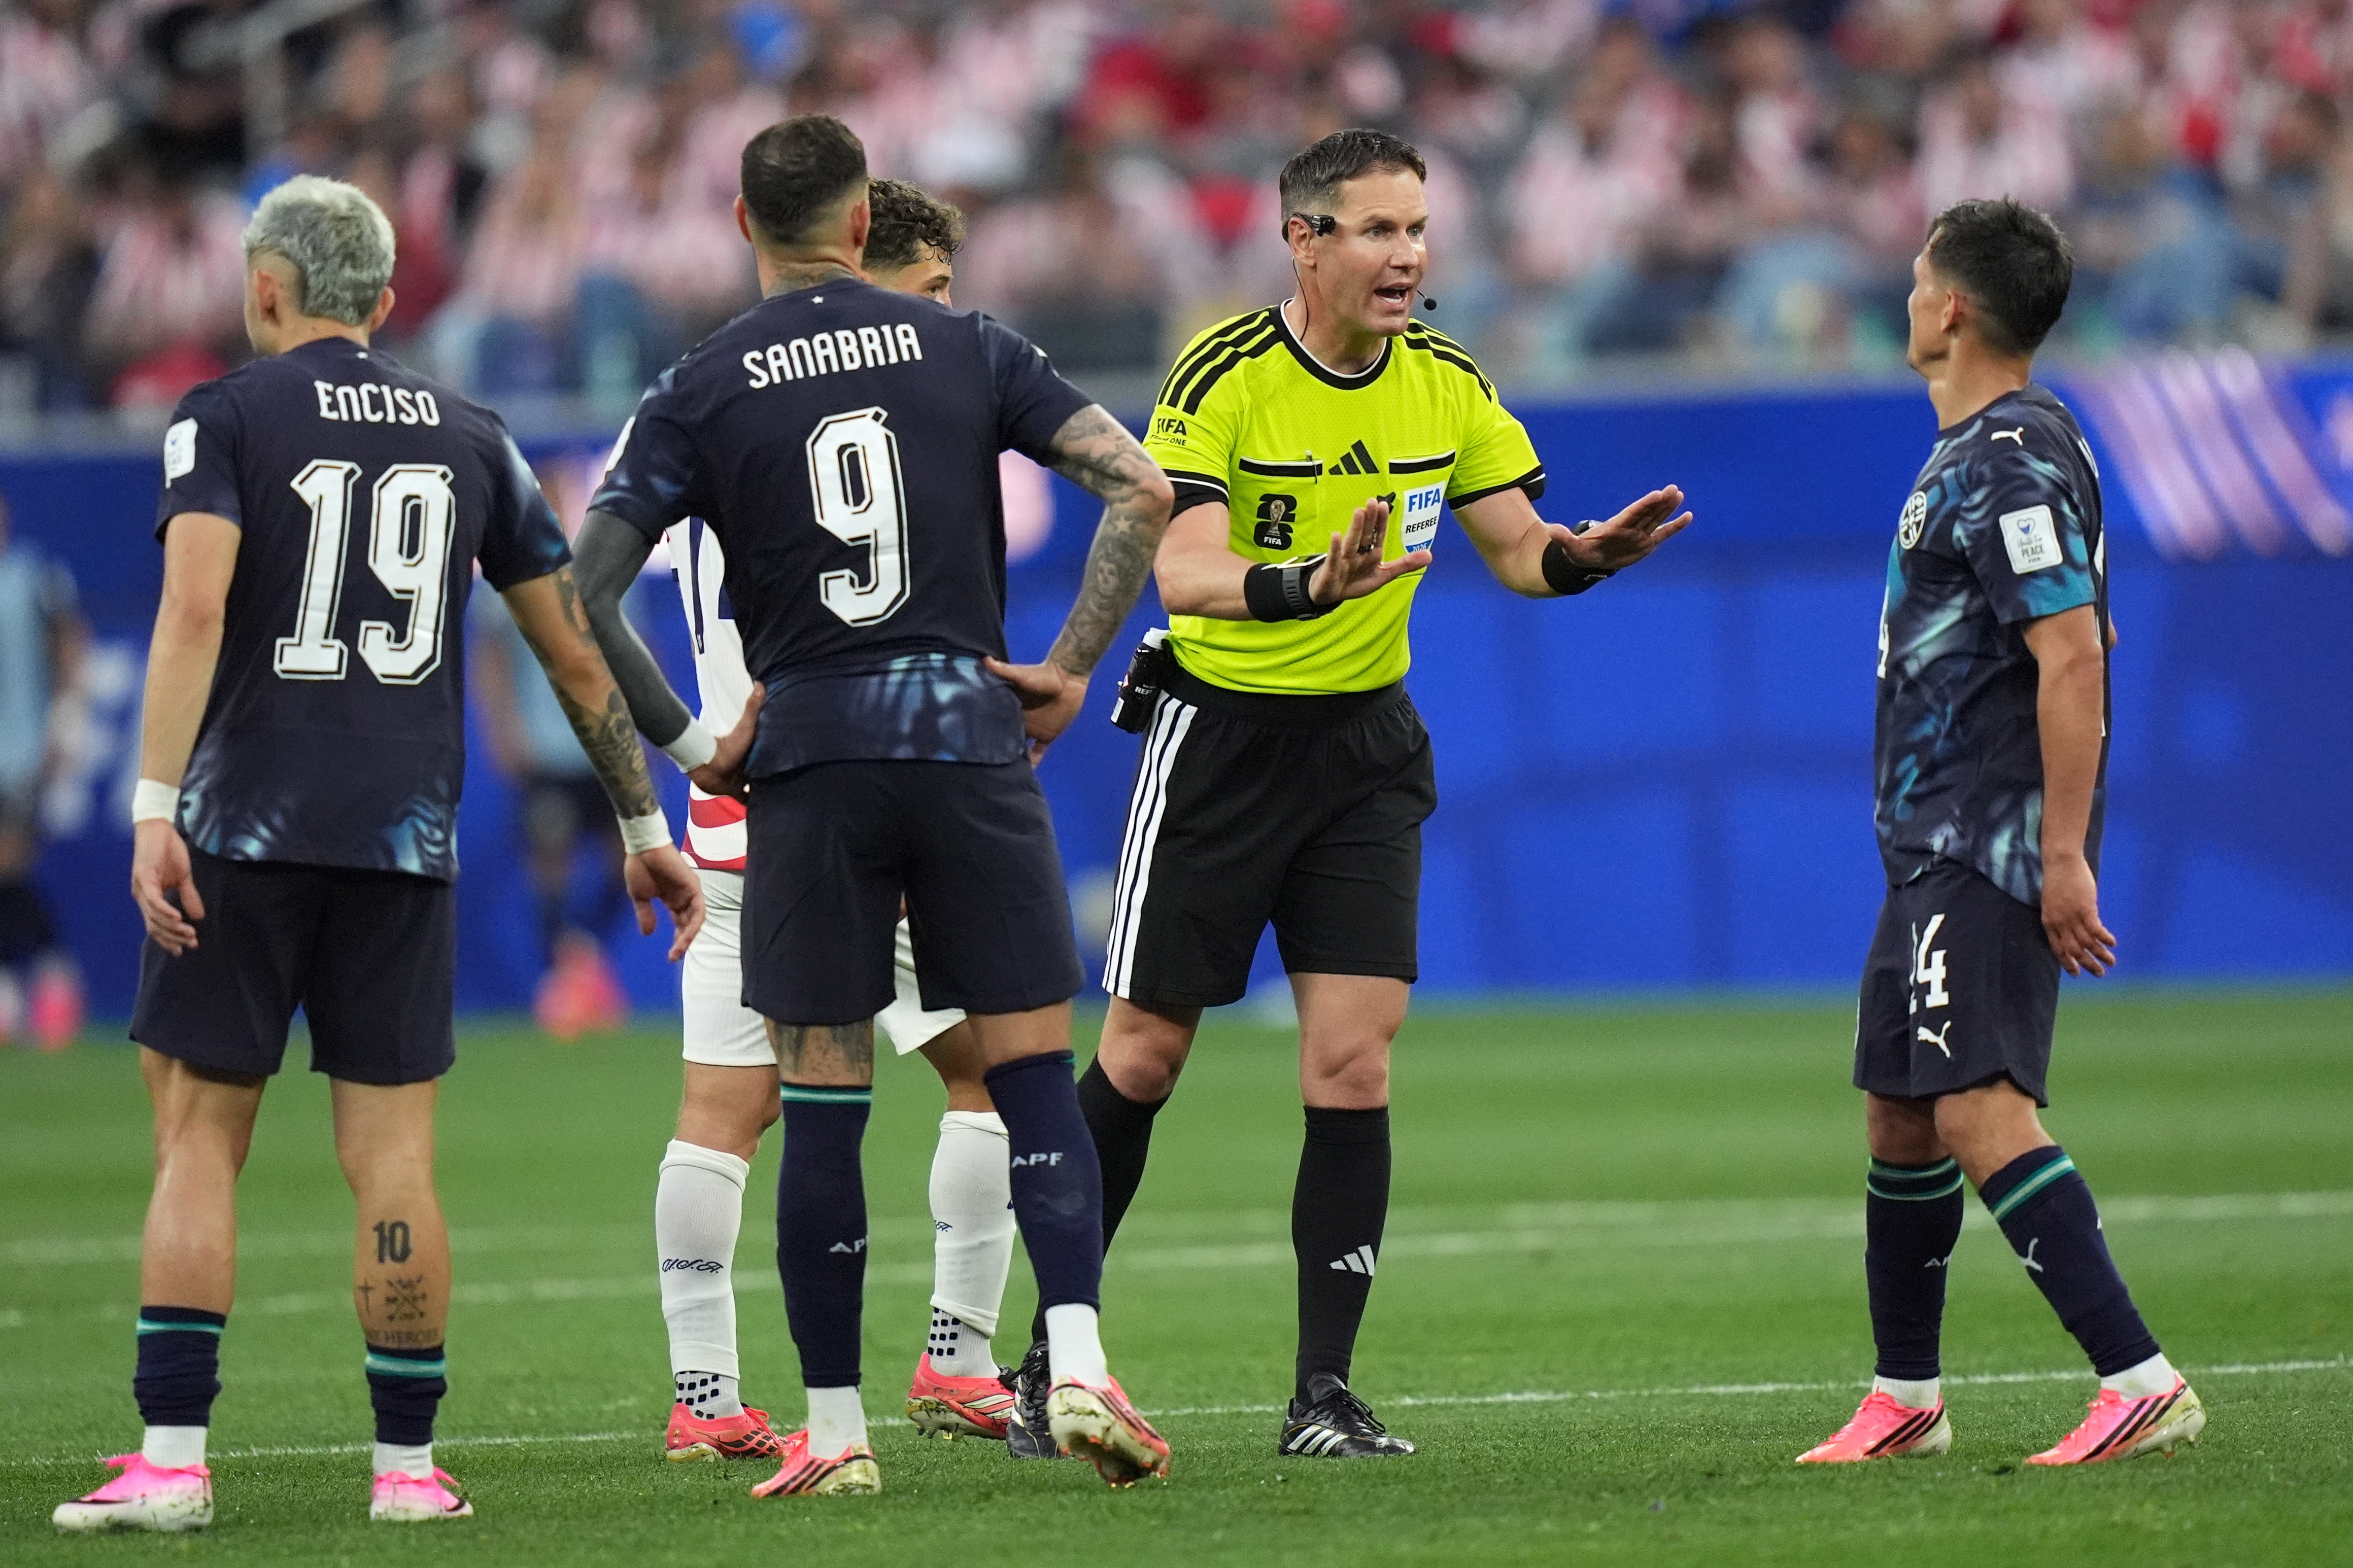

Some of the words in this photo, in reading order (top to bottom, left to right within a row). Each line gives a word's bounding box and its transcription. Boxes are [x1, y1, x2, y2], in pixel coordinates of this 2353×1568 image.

[742, 323, 923, 389] SANABRIA
[314, 380, 440, 426] ENCISO
[1156, 418, 1187, 436] FIFA
[1170, 438, 1186, 446] ONE
[1408, 487, 1441, 512] FIFA
[806, 406, 910, 627] 9
[1406, 516, 1438, 534] REFEREE
[1264, 536, 1282, 546] FIFA
[274, 459, 455, 685] 19
[1011, 1152, 1063, 1169] APF
[373, 1221, 413, 1264] 10
[829, 1234, 869, 1253] AP
